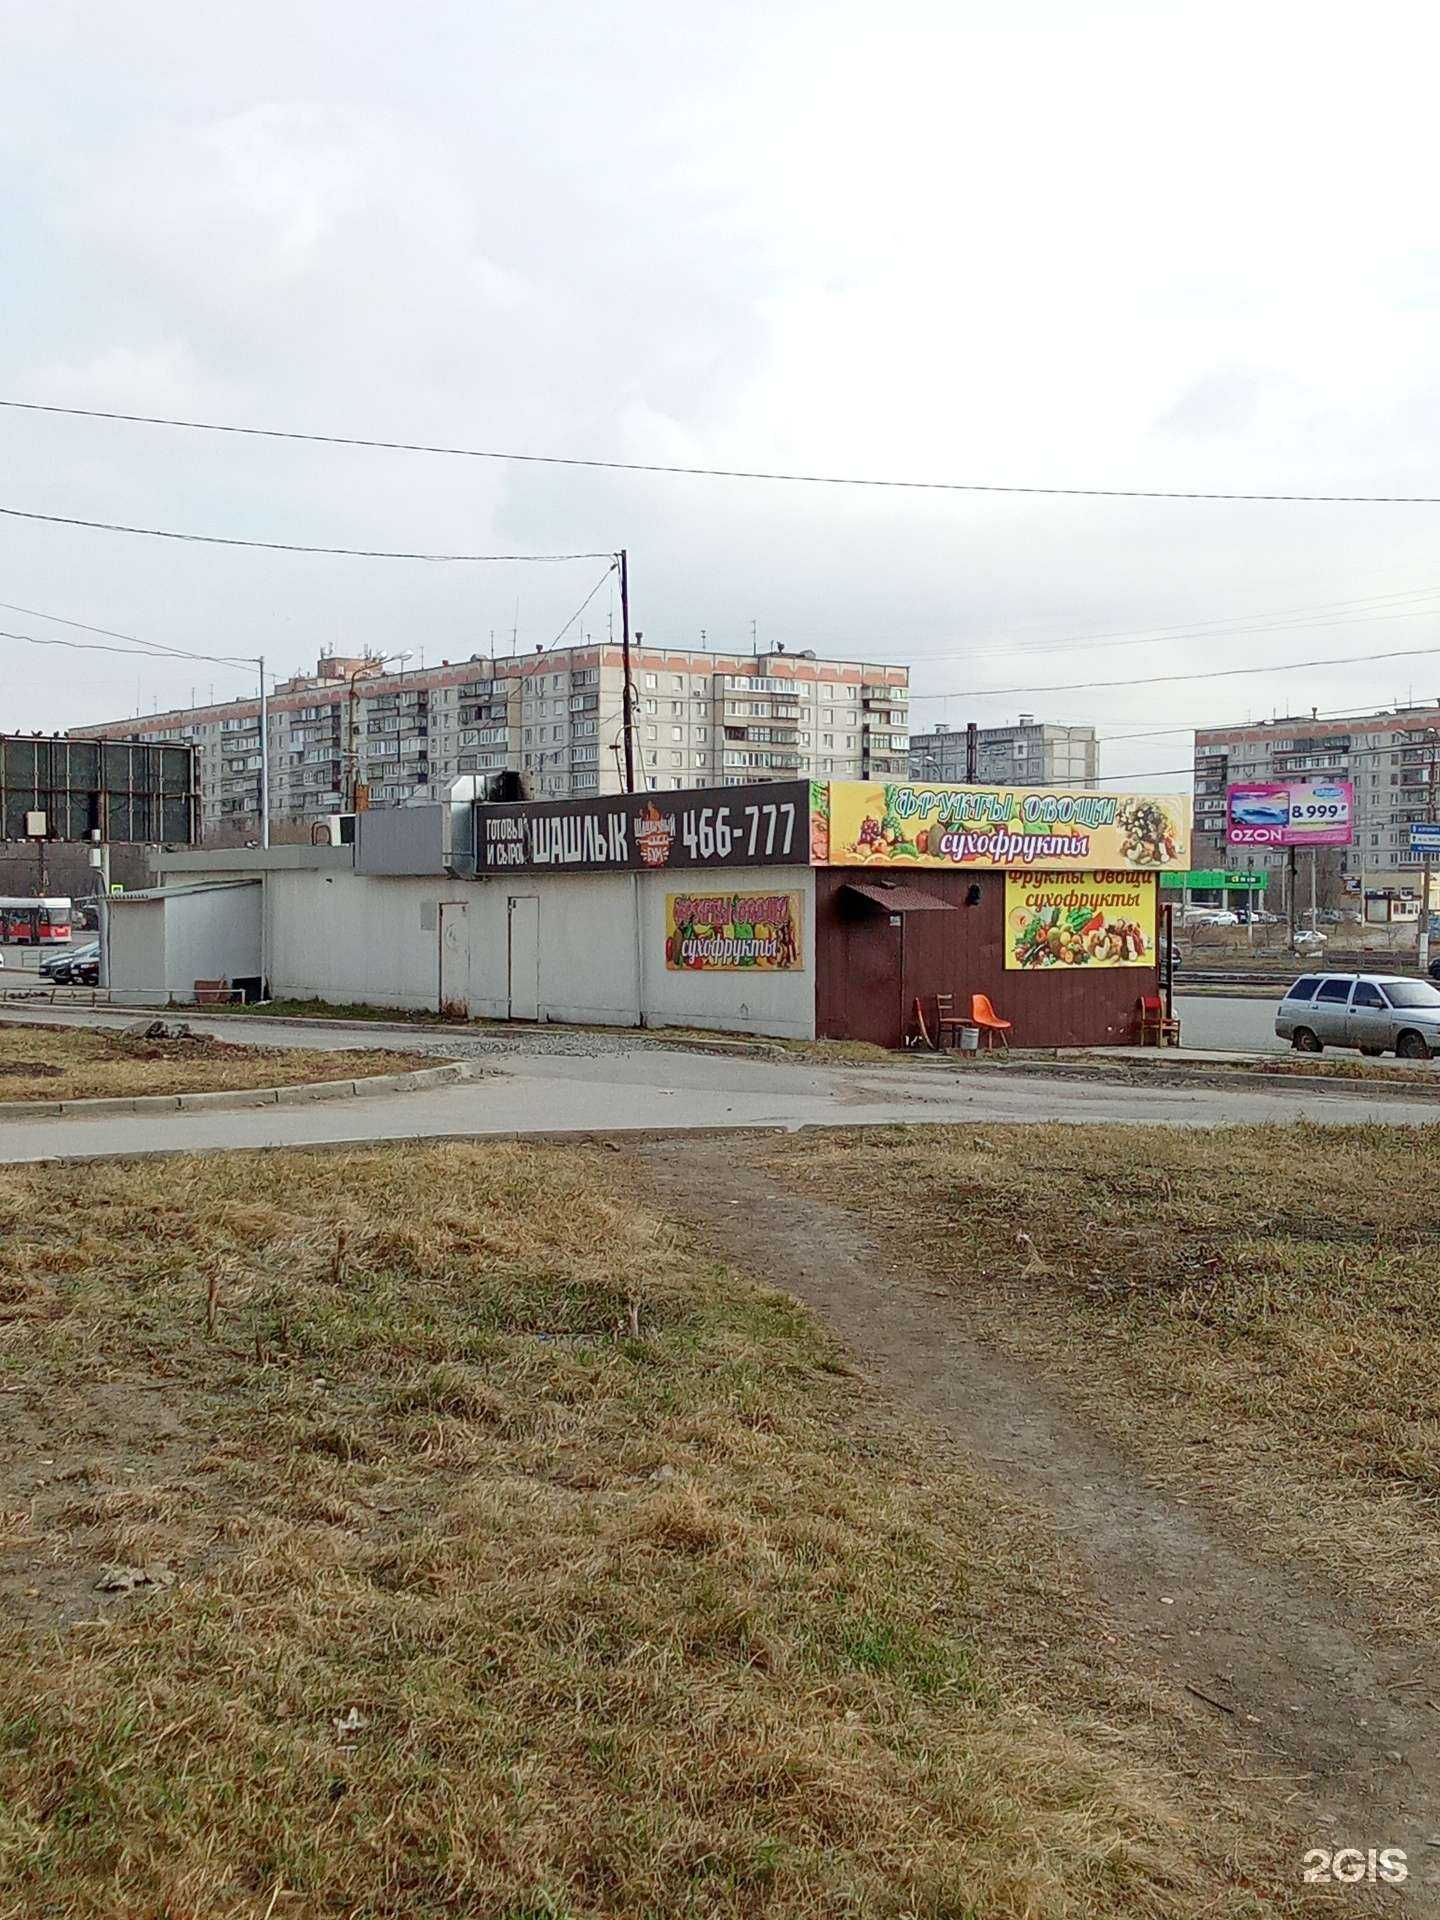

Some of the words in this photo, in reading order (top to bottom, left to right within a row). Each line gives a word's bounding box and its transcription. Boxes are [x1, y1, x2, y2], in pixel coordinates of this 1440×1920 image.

[896, 787, 1015, 821] ФРУКТЫ
[1021, 795, 1119, 829] ОВОЩИ
[532, 812, 628, 864] ШАШЛЫК
[682, 802, 796, 860] 466-777
[939, 829, 1090, 864] сухофрукты
[1231, 829, 1283, 842] OZON
[1025, 889, 1141, 912] сухофрукты
[681, 933, 777, 965] сухофрукты
